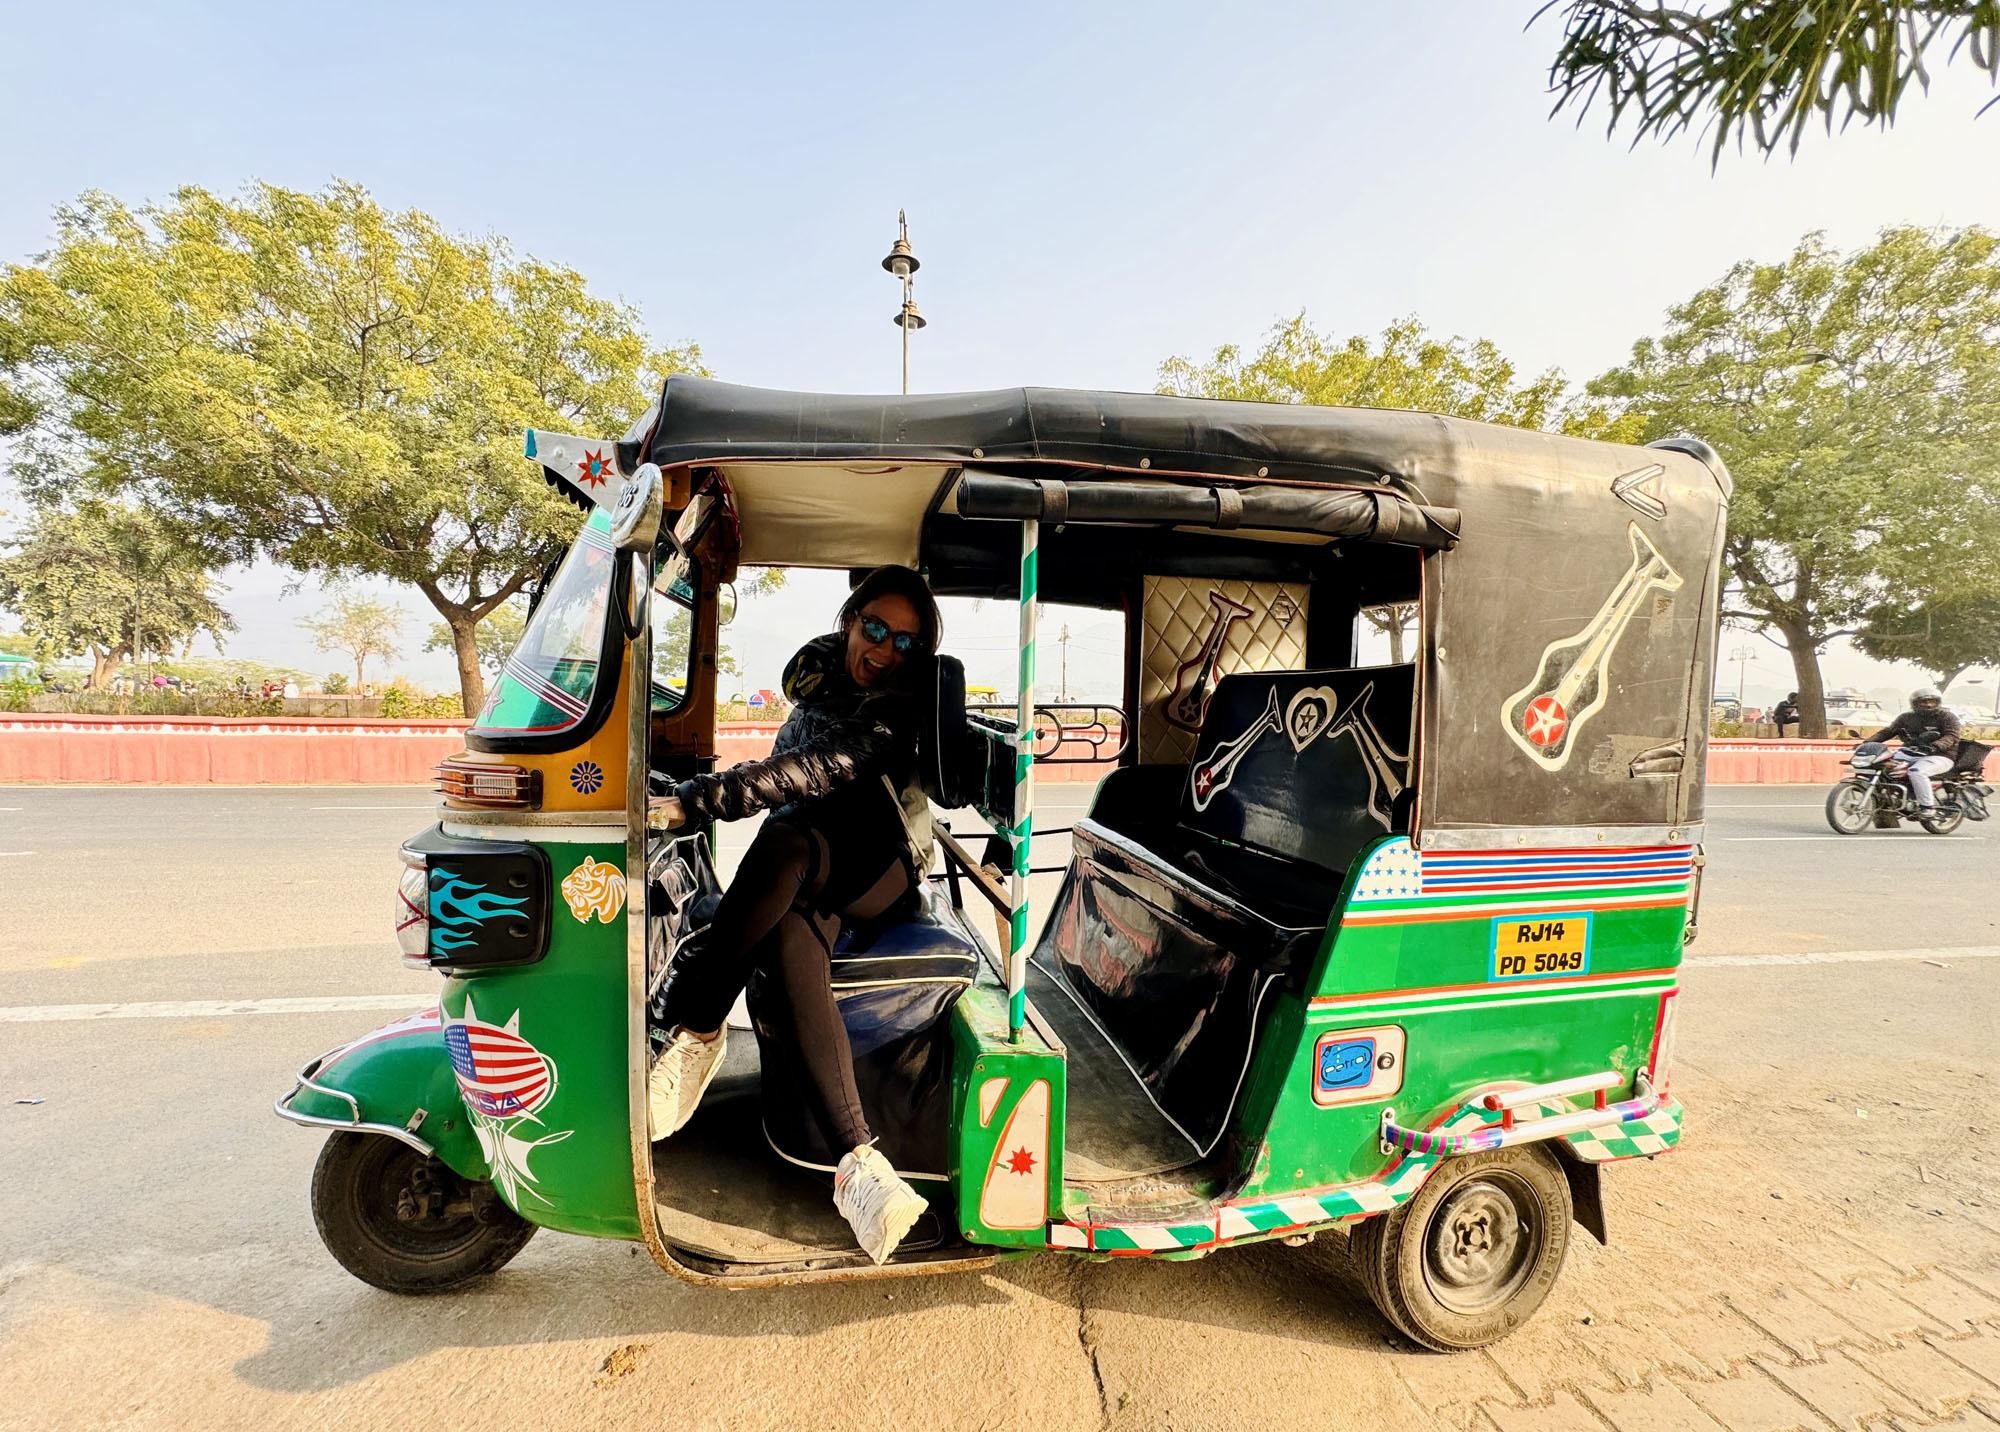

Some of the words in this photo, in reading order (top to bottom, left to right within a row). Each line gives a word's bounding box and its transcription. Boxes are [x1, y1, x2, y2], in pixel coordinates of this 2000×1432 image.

[1517, 922, 1565, 943] RJ14
[1500, 956, 1527, 975] PD
[1534, 952, 1582, 972] 5049
[462, 1086, 524, 1117] USA
